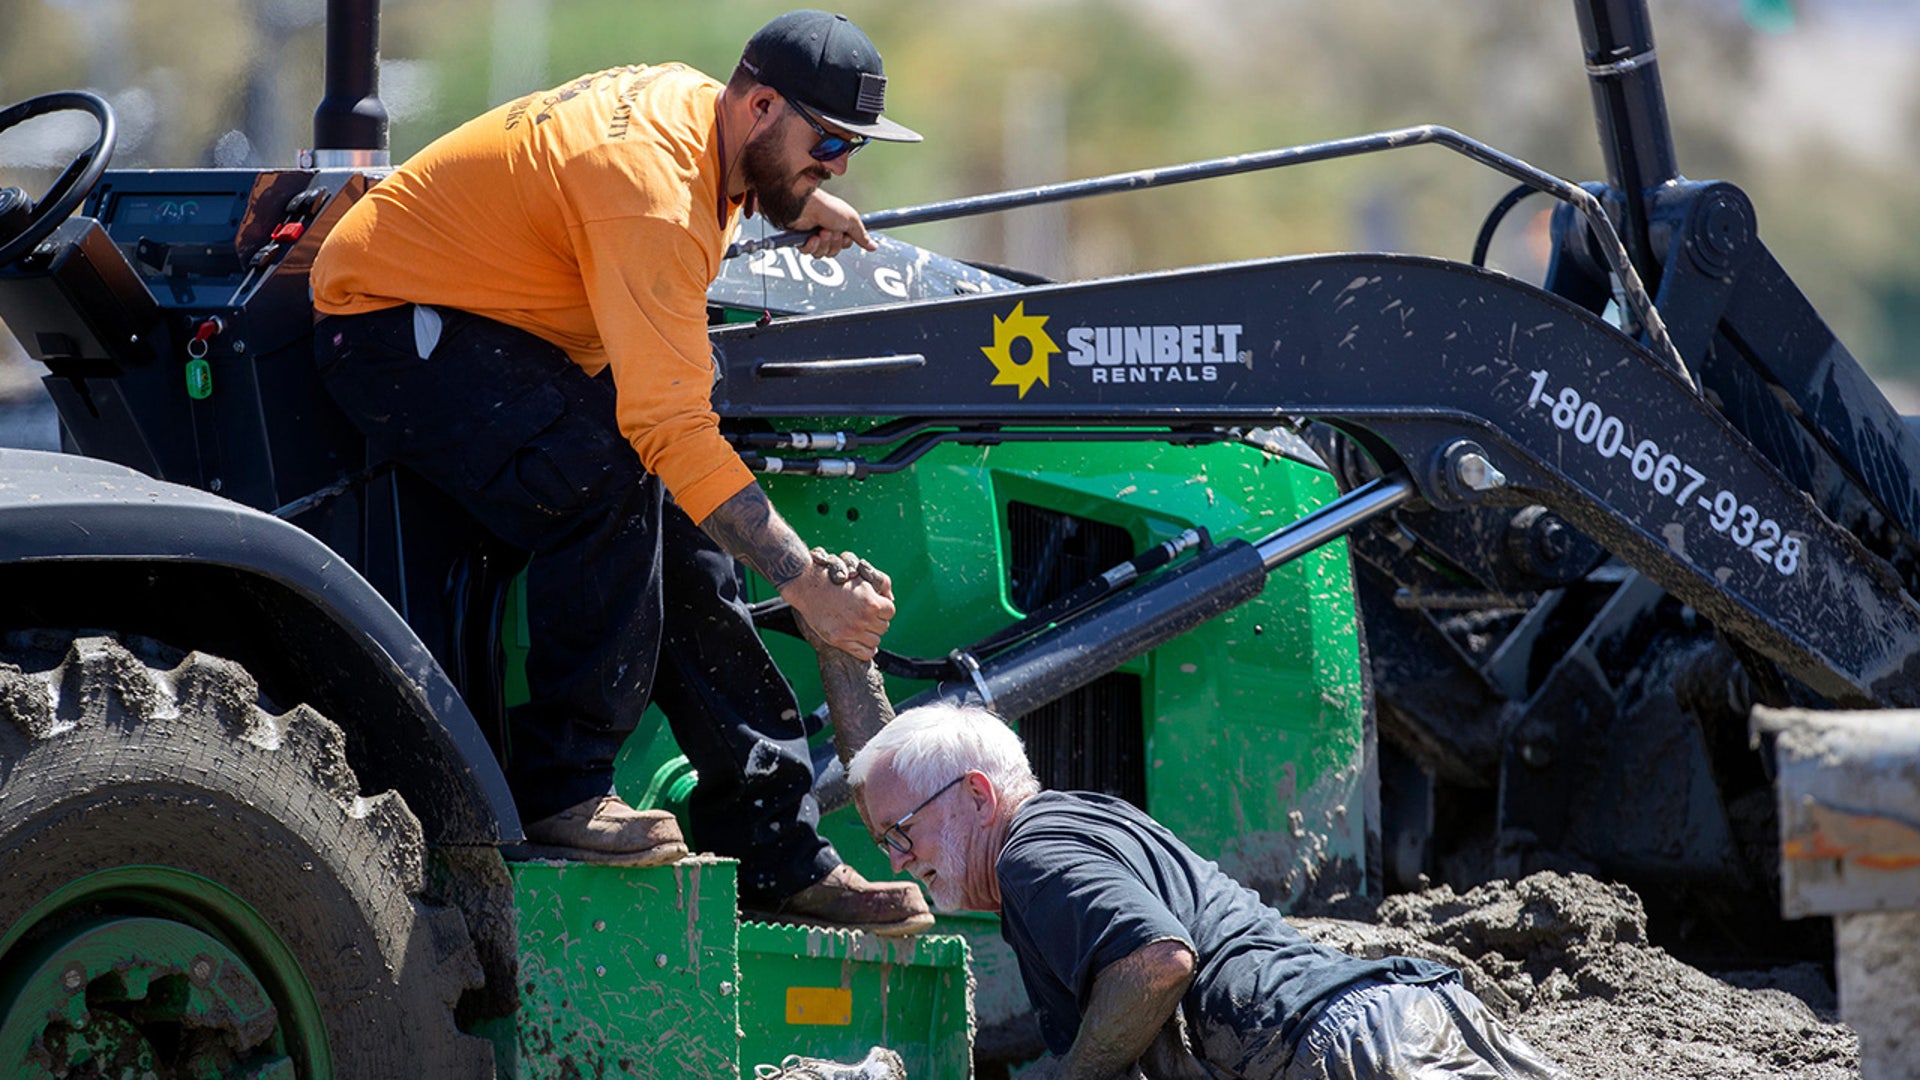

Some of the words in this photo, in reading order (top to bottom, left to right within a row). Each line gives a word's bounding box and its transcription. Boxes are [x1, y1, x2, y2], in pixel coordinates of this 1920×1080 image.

[607, 104, 632, 140] CITY
[1067, 324, 1243, 366] SUNBELT
[1091, 365, 1218, 383] RENTALS
[1528, 368, 1802, 576] 1-800-667-9328
